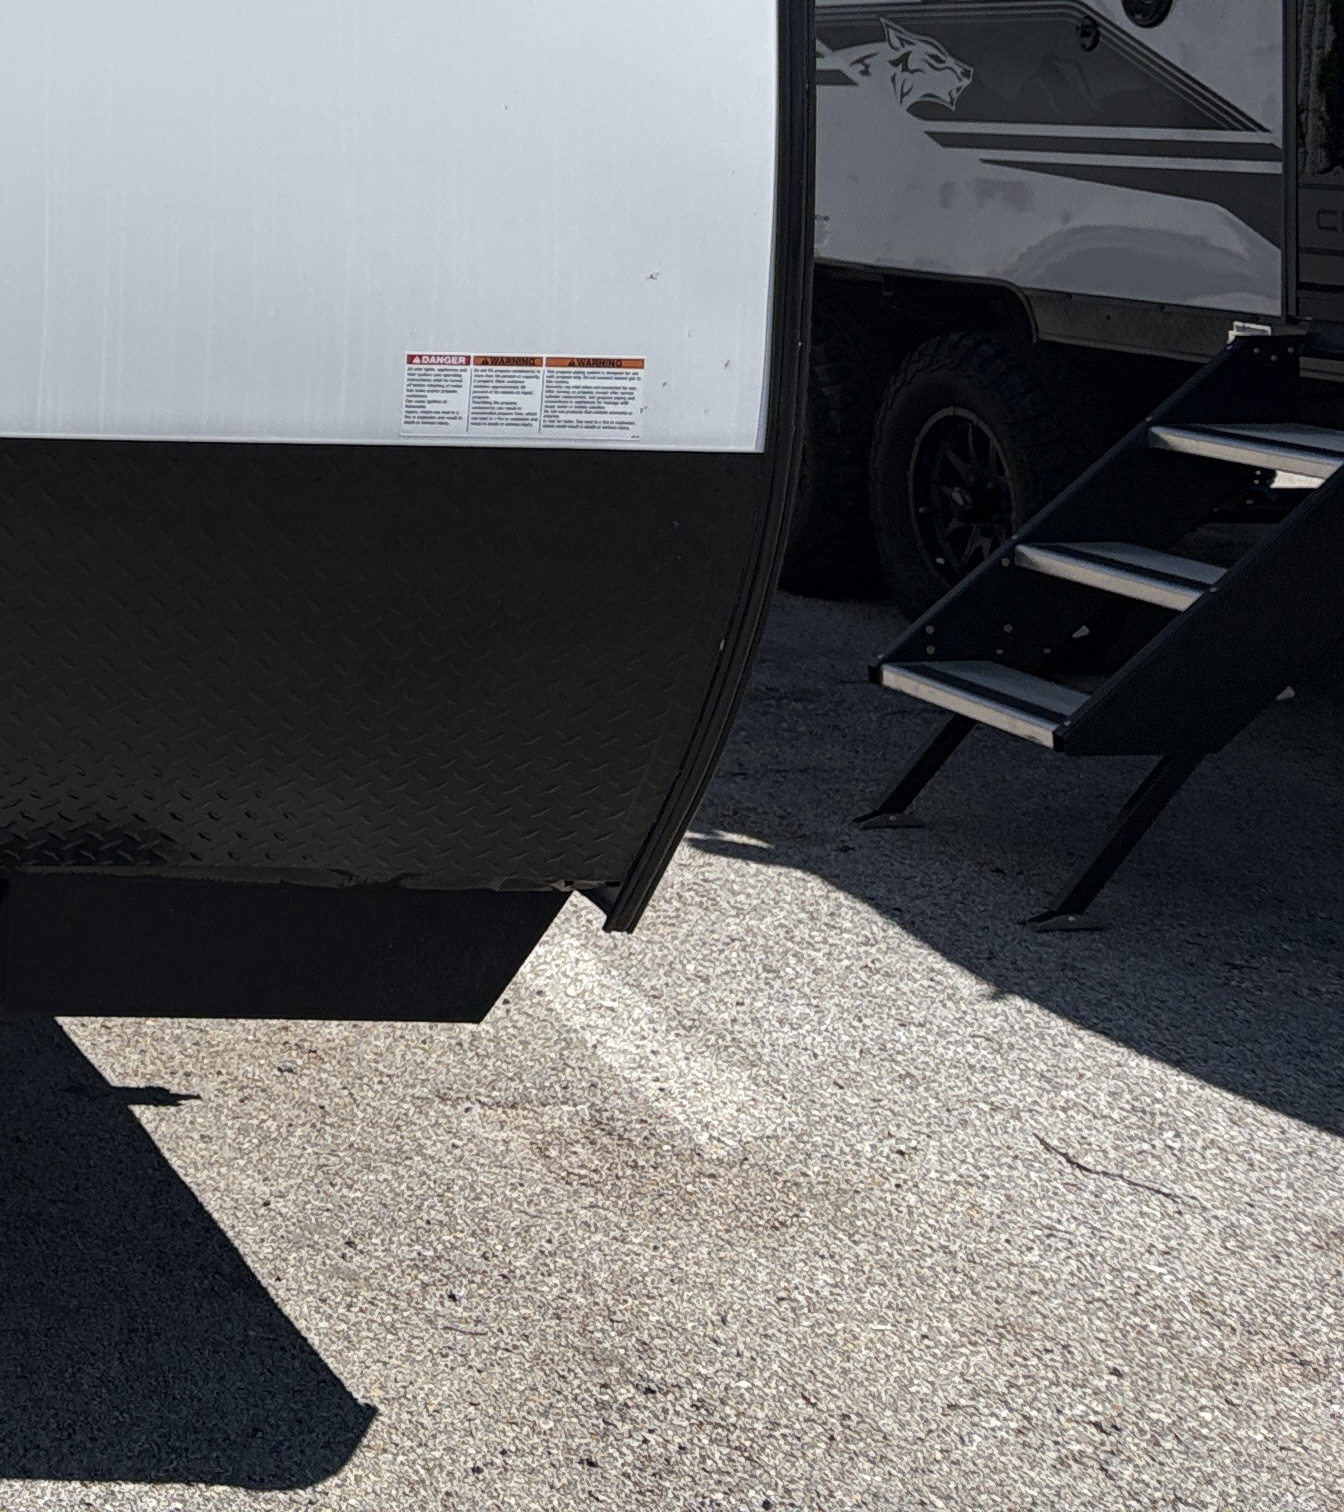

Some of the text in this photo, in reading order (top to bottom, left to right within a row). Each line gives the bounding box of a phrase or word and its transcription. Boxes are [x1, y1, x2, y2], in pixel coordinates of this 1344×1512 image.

[421, 355, 467, 365] DANGER
[488, 357, 535, 366] WARNING
[577, 359, 623, 368] WARNING
